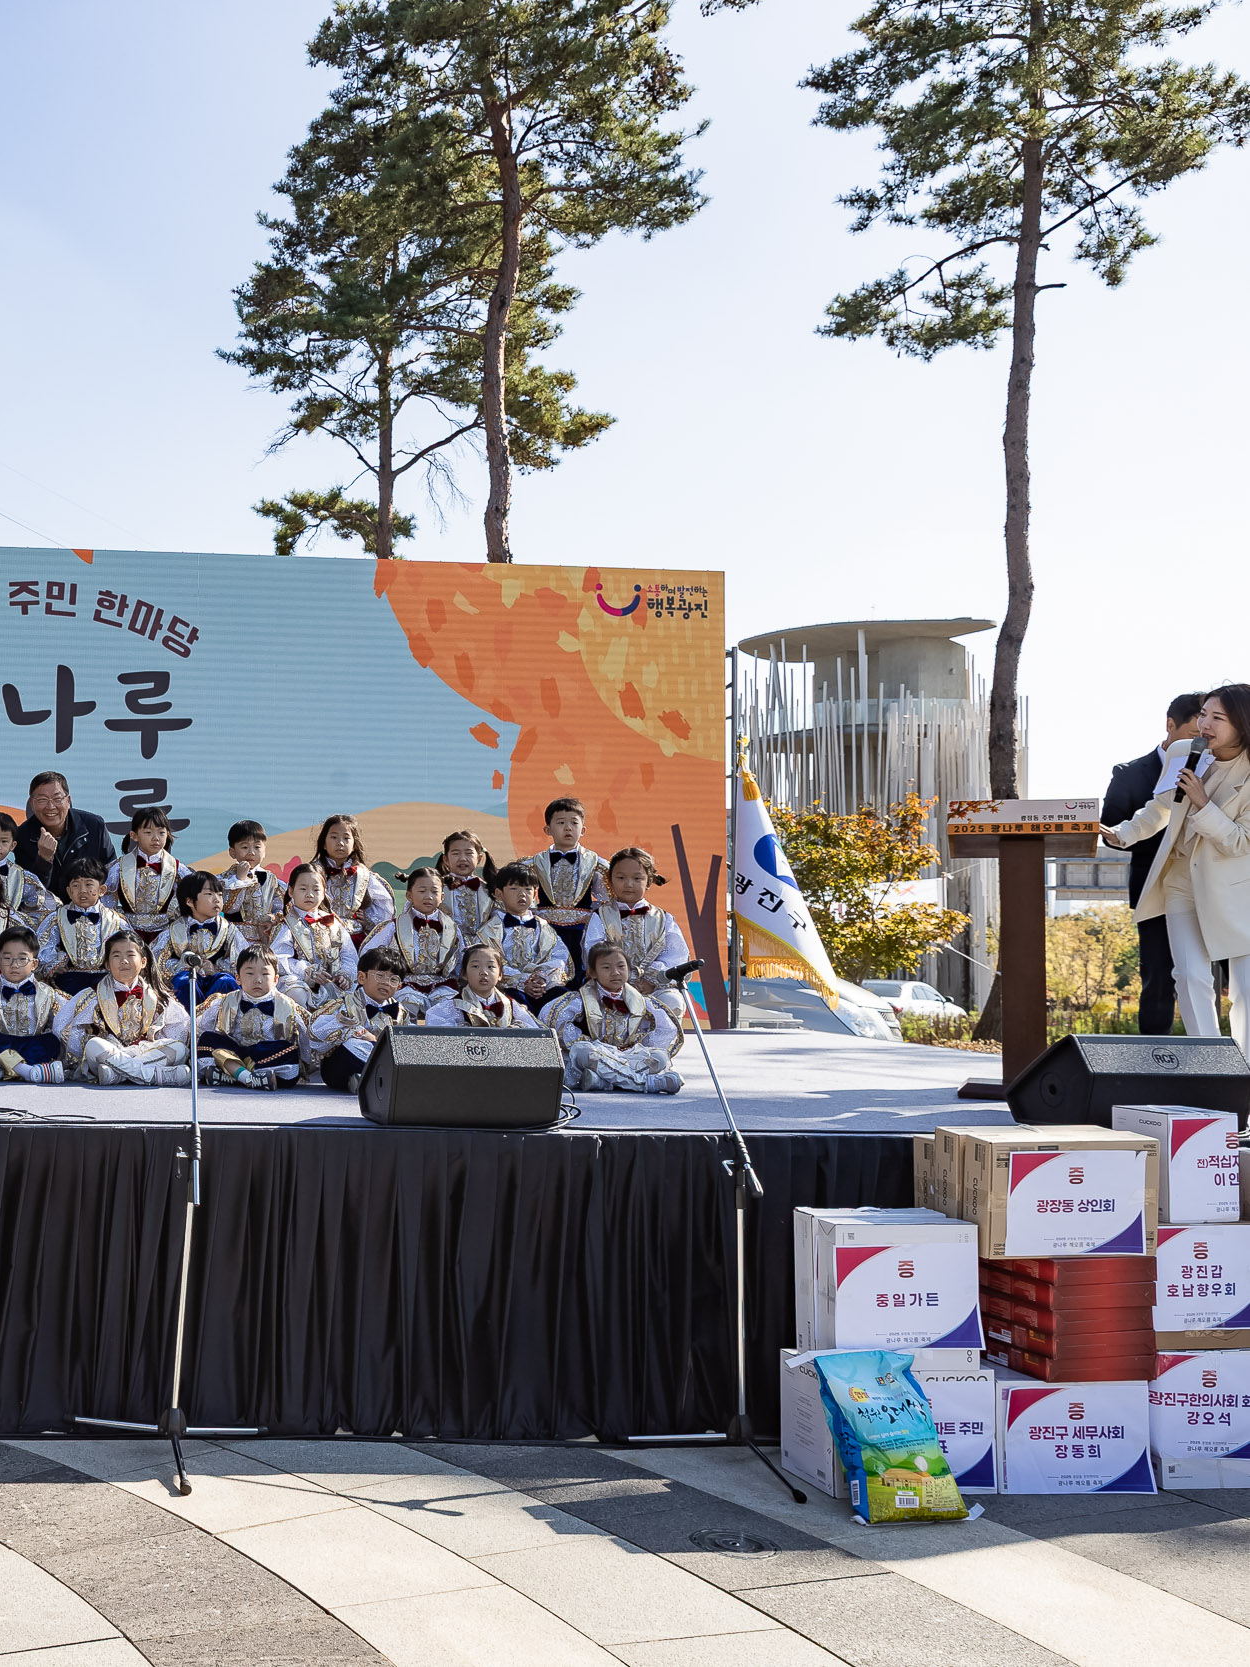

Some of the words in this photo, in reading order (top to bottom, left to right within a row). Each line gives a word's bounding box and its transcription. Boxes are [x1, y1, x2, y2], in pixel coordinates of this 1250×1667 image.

[646, 596, 708, 619] 행복광진
[8, 580, 78, 618] 주민
[92, 588, 200, 659] 한마당
[953, 825, 984, 833] 2025
[990, 824, 1024, 833] 광나루
[734, 872, 807, 932] 광진구
[466, 1045, 487, 1056] RCF
[1154, 1054, 1175, 1063] RCF
[1068, 1166, 1085, 1185] 증
[1036, 1199, 1075, 1214] 광장동
[1077, 1198, 1115, 1213] 상인회
[1193, 1241, 1208, 1260] 증
[897, 1260, 915, 1279] 증
[1167, 1282, 1236, 1298] 호남향우회
[876, 1292, 939, 1308] 중일가든
[1201, 1370, 1218, 1388] 증
[1148, 1390, 1238, 1408] 광진구한의사회
[1068, 1402, 1085, 1421] 증
[958, 1421, 984, 1436] 주민
[1028, 1425, 1069, 1441] 광진구
[1071, 1425, 1125, 1440] 세무사회
